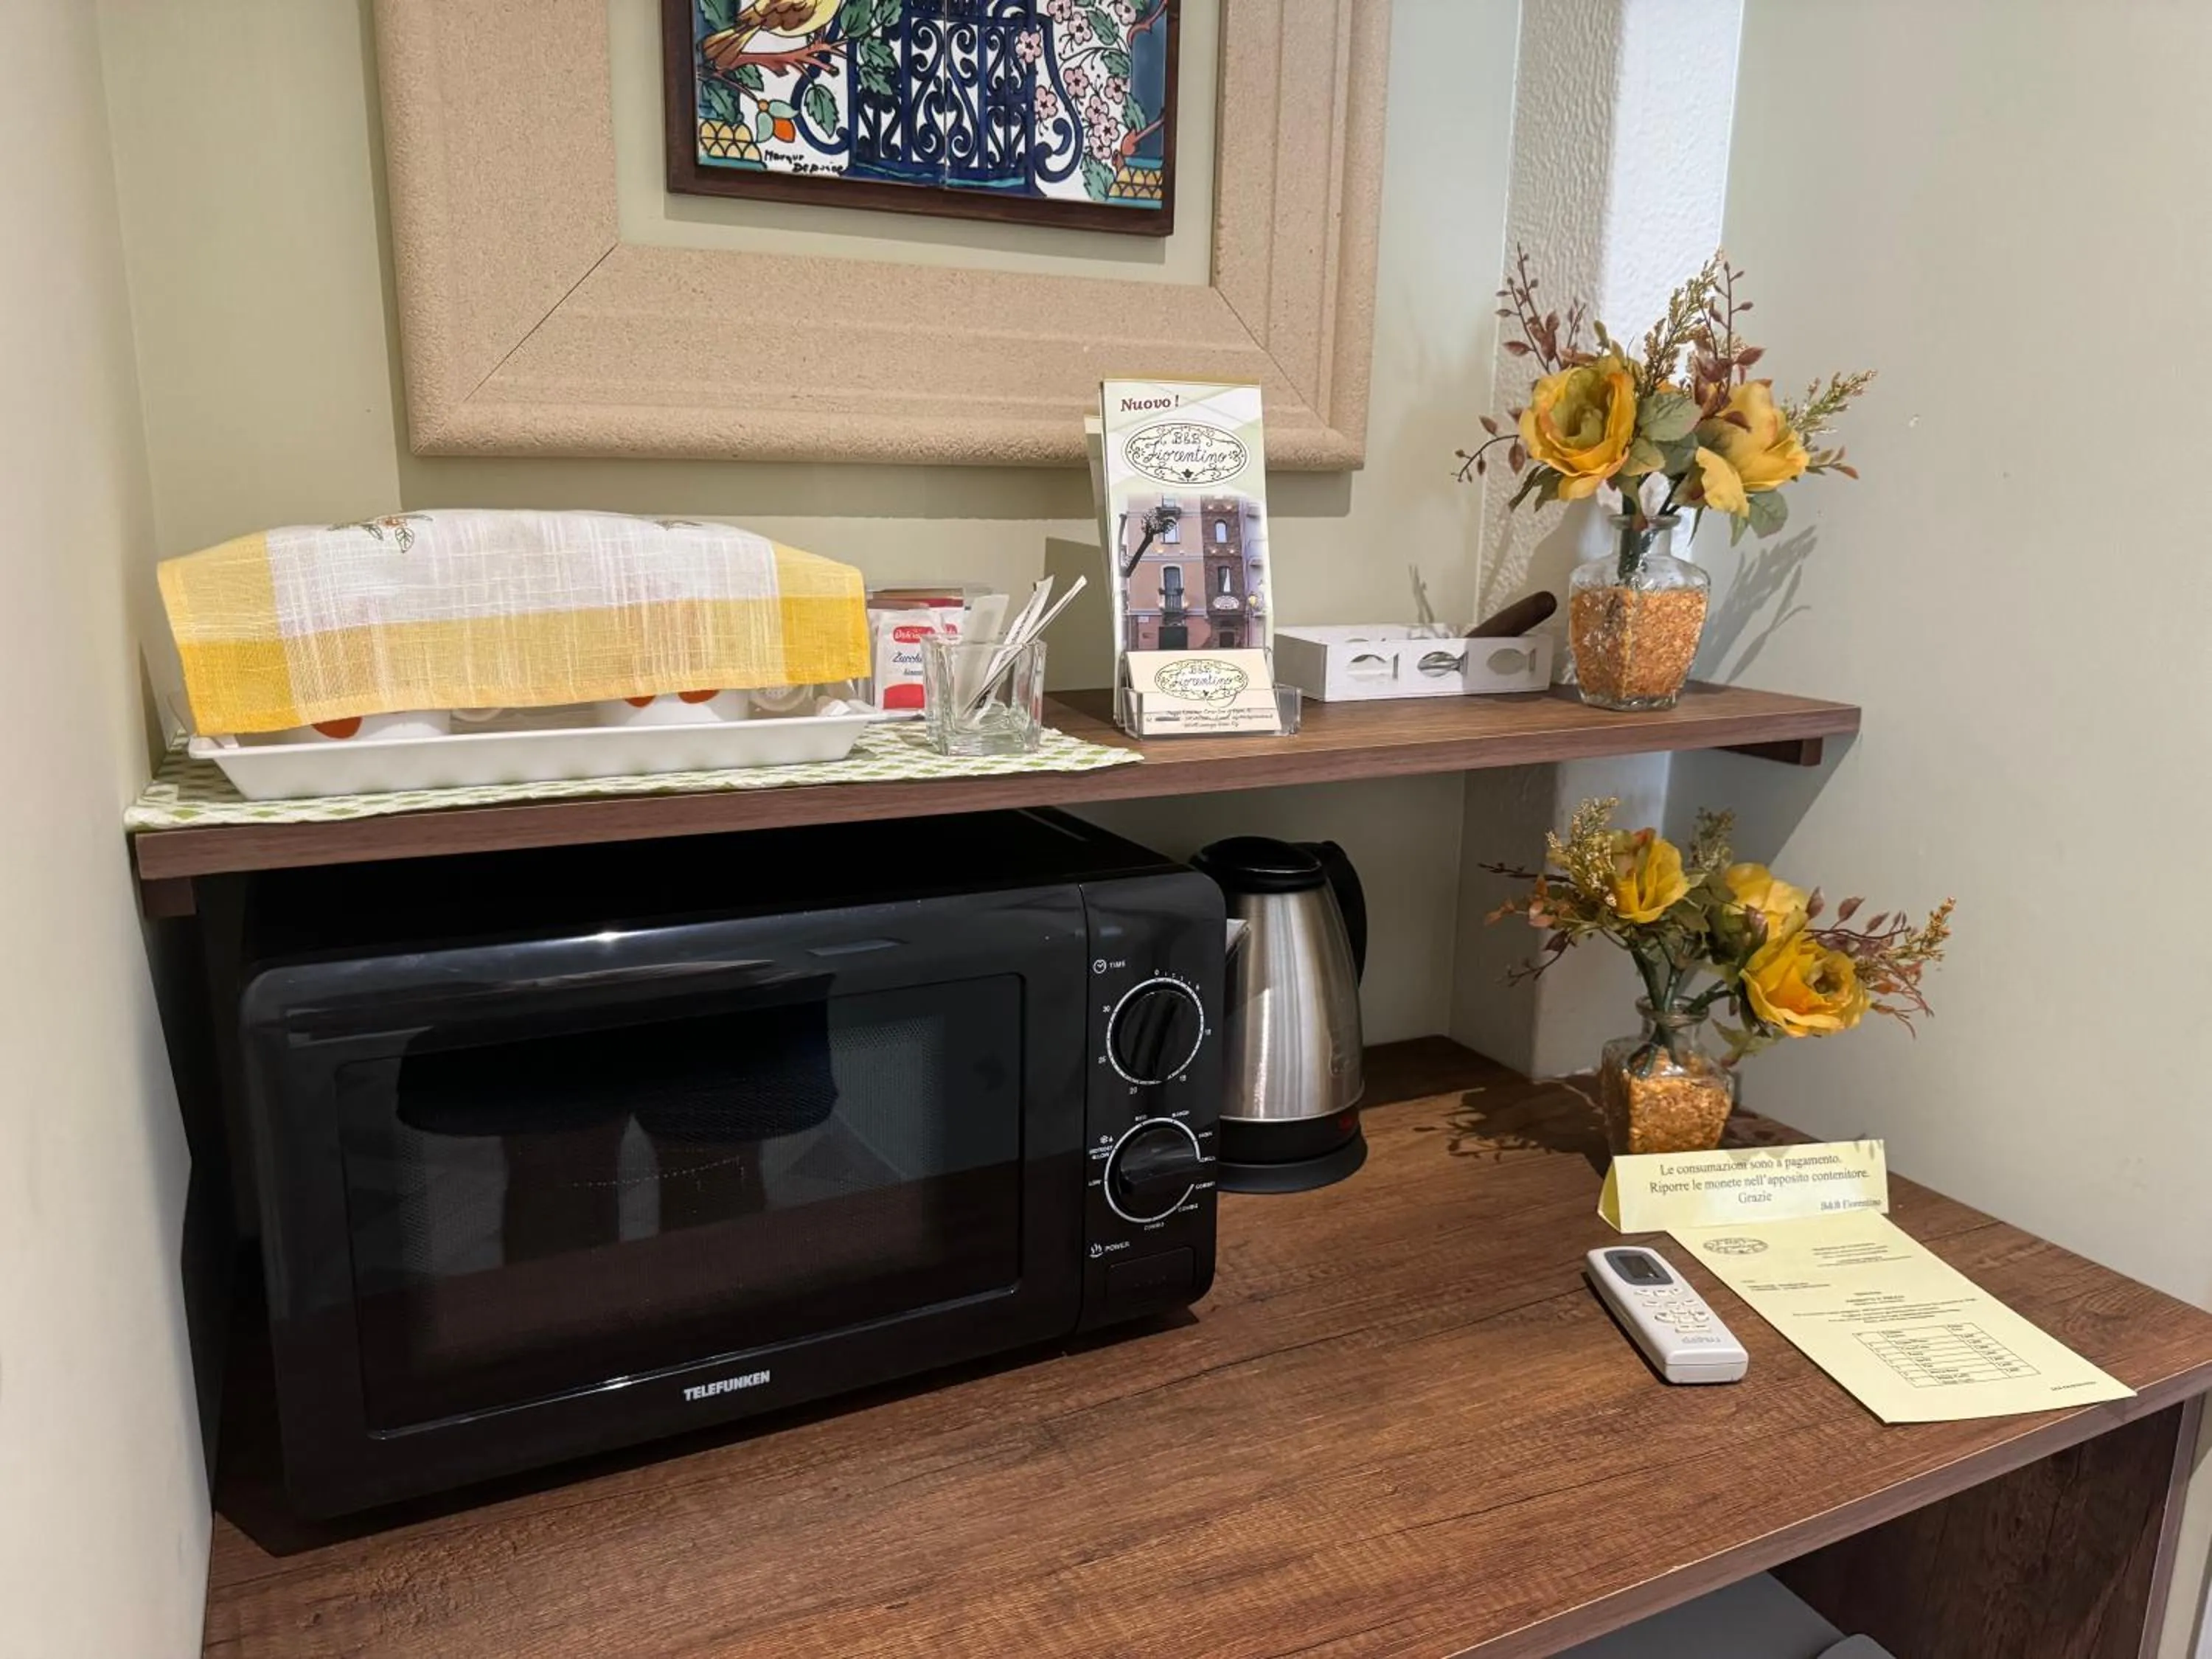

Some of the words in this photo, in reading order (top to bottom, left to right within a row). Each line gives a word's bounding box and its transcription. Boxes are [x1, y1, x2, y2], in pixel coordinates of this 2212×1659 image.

[1120, 398, 1172, 411] Nuovo
[1144, 438, 1227, 463] Fiorentino
[1110, 960, 1126, 968] TIME
[1660, 1164, 1674, 1175] Le
[1676, 1160, 1747, 1175] consumazioni
[1750, 1159, 1773, 1169] sono
[1776, 1160, 1782, 1168] a
[1784, 1154, 1842, 1169] pagamento.
[1649, 1181, 1689, 1196] Riporre
[1692, 1179, 1703, 1190] le
[1704, 1178, 1741, 1190] monete
[1812, 1167, 1869, 1181] contenitore.
[1738, 1190, 1773, 1204] Grazie
[1105, 1241, 1130, 1251] POWER
[684, 1369, 771, 1401] TELEFUNKEN
